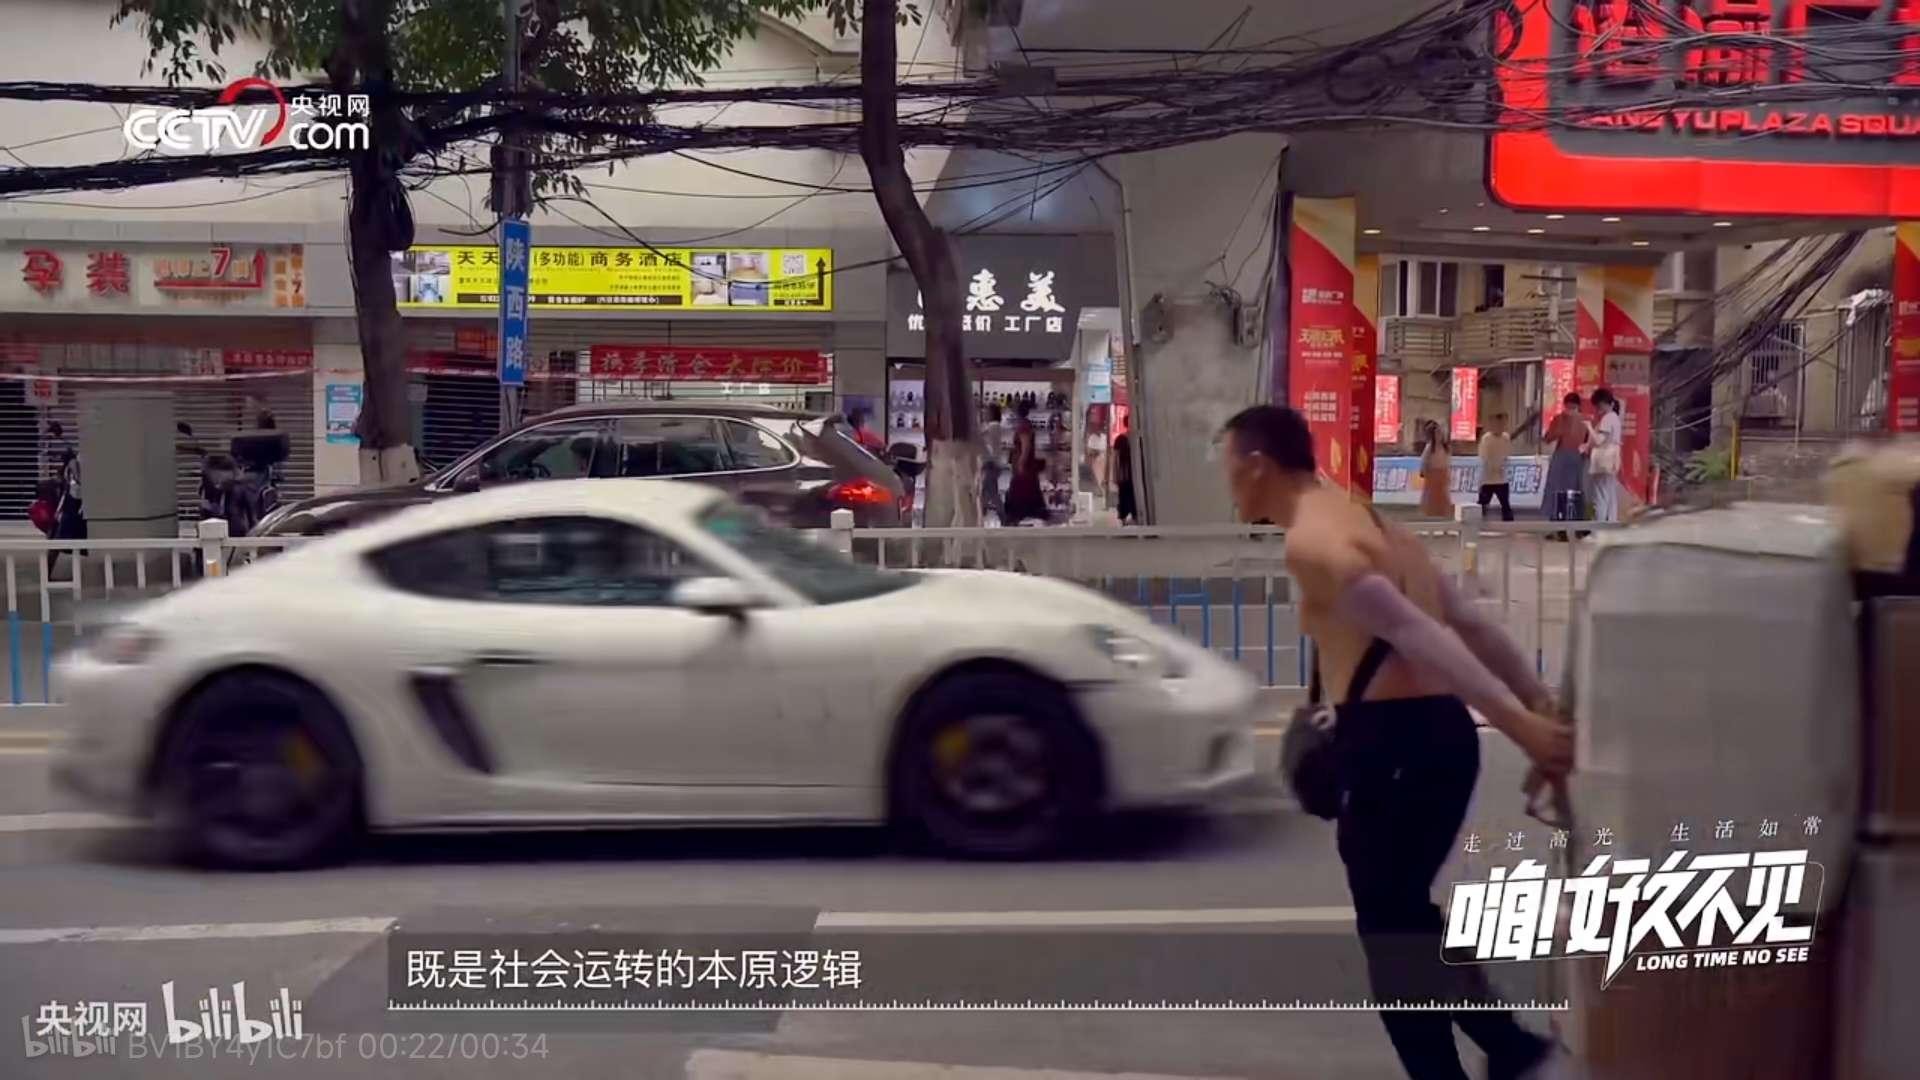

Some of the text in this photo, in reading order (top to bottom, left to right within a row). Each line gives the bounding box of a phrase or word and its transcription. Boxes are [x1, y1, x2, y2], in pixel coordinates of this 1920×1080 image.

[22, 248, 131, 297] 孕装
[505, 236, 526, 371] 陕西路
[601, 350, 803, 374] 换季清仓大降价
